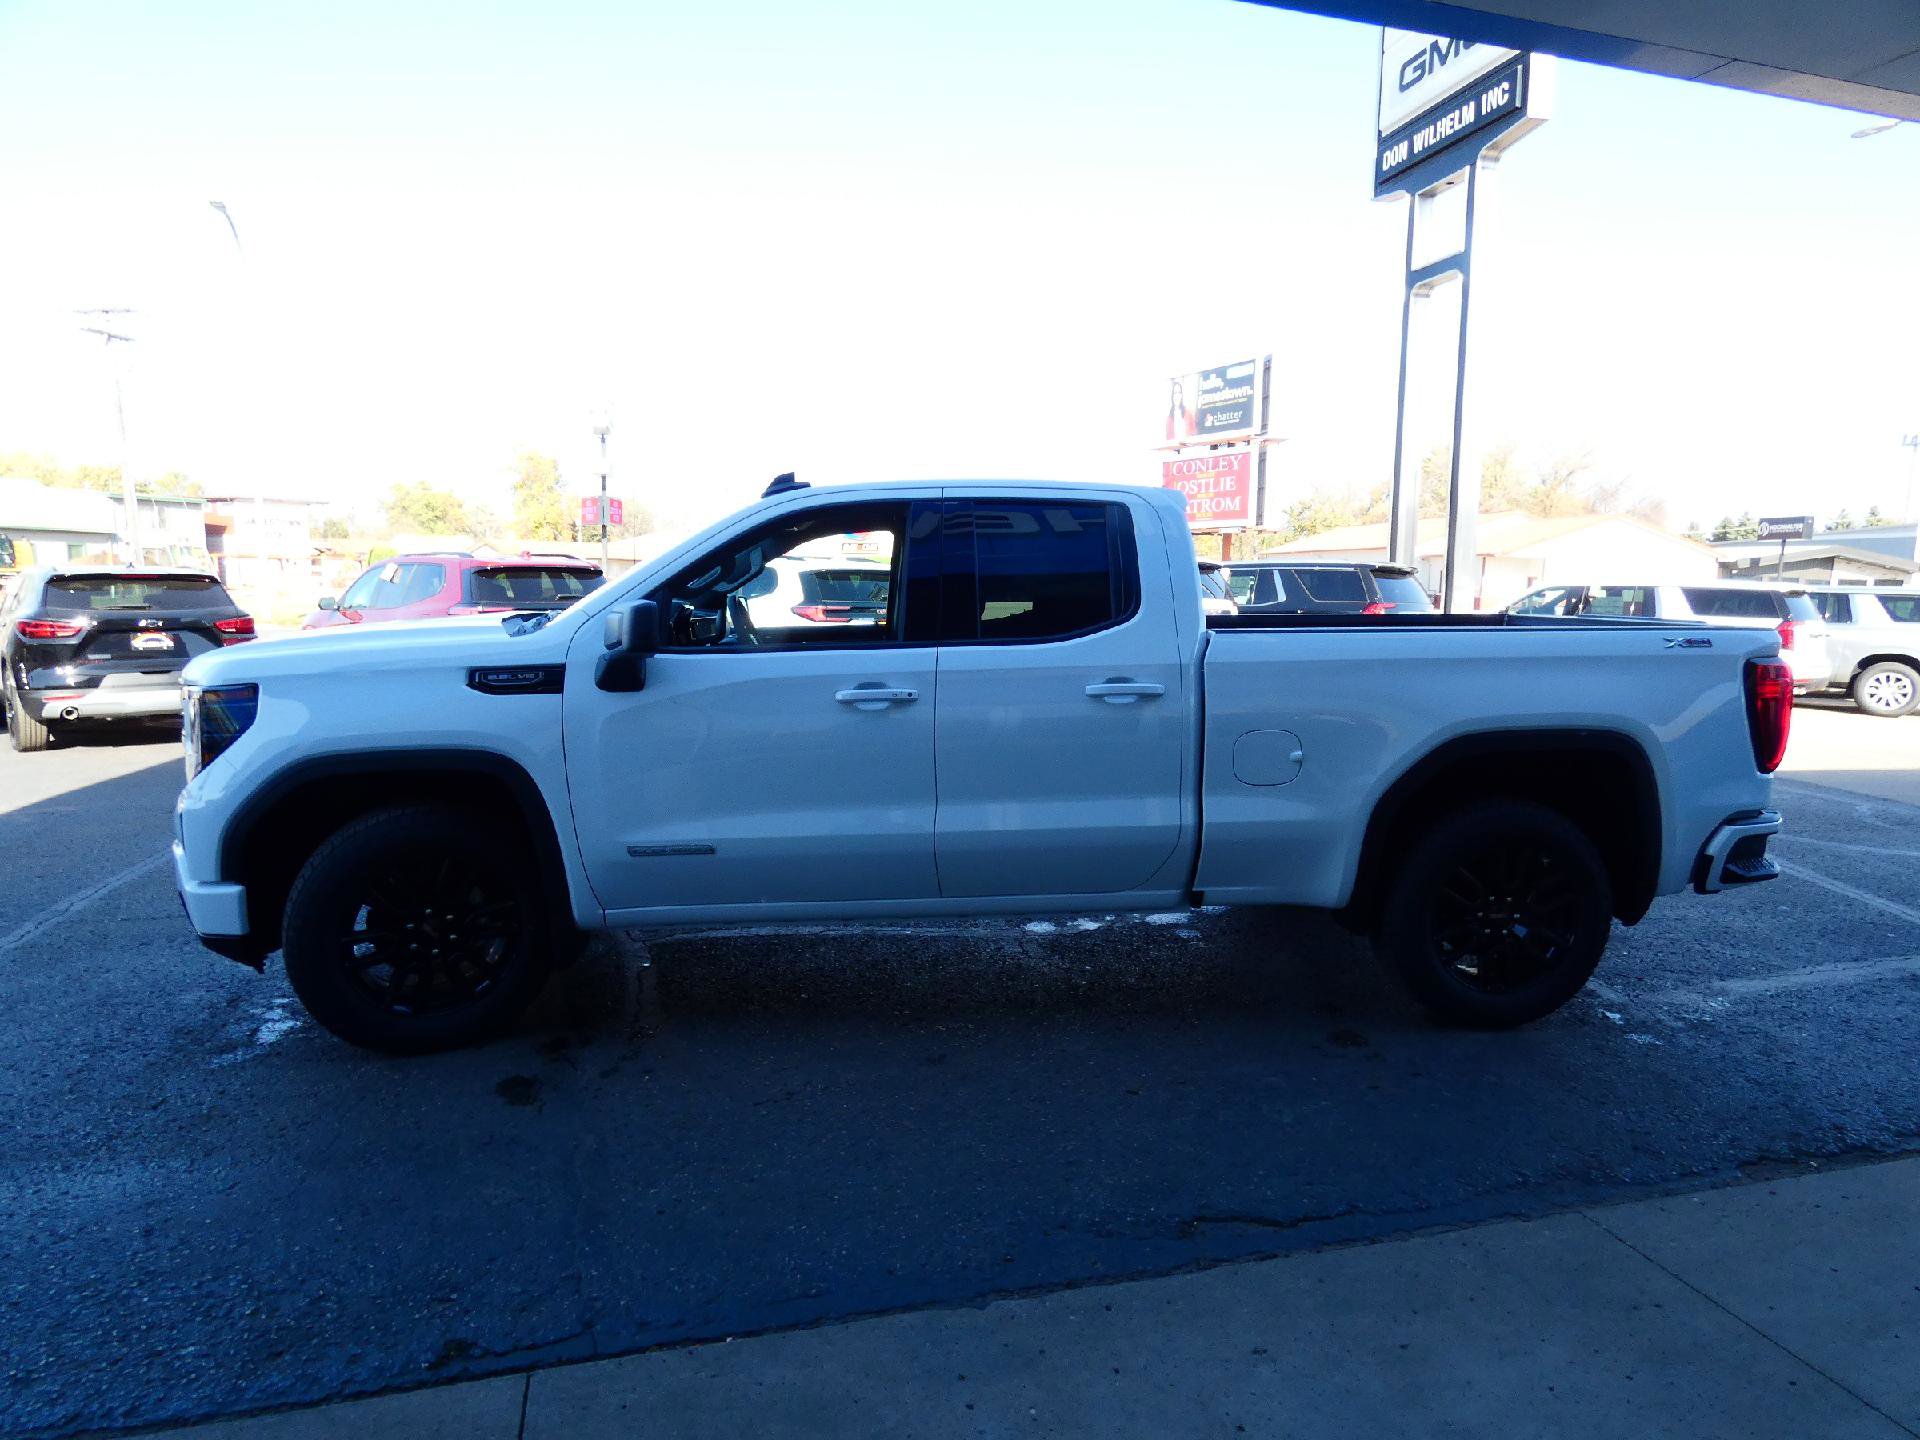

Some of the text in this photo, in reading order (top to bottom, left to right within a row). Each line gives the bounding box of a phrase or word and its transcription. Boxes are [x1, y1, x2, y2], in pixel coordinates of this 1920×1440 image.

[1382, 82, 1509, 172] DON WILHELM INC
[1173, 455, 1243, 476] CONLEY
